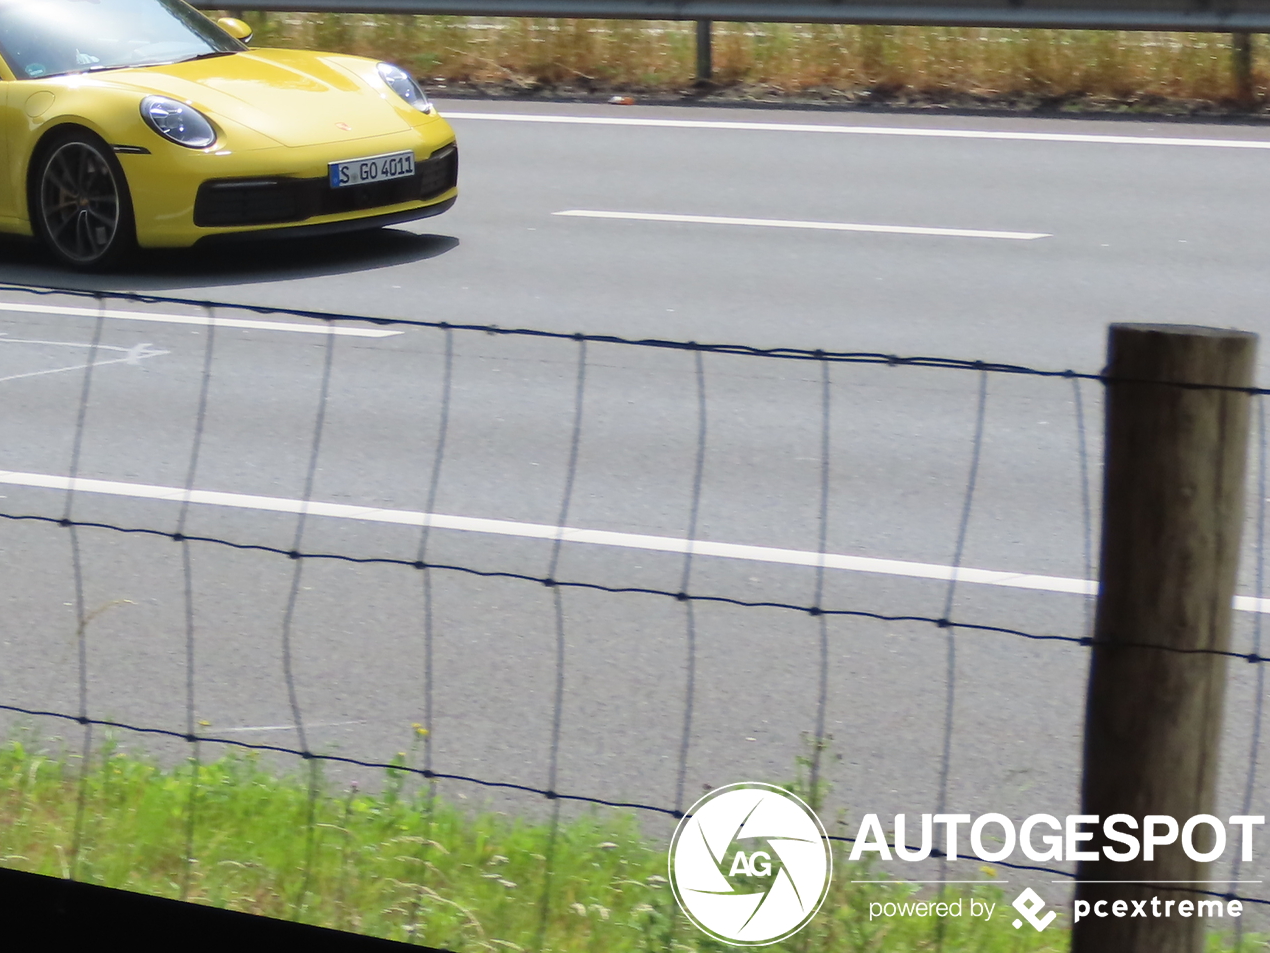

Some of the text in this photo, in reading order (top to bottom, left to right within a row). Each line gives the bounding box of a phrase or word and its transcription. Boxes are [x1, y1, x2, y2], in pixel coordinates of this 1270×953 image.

[340, 156, 413, 183] S GO 4011
